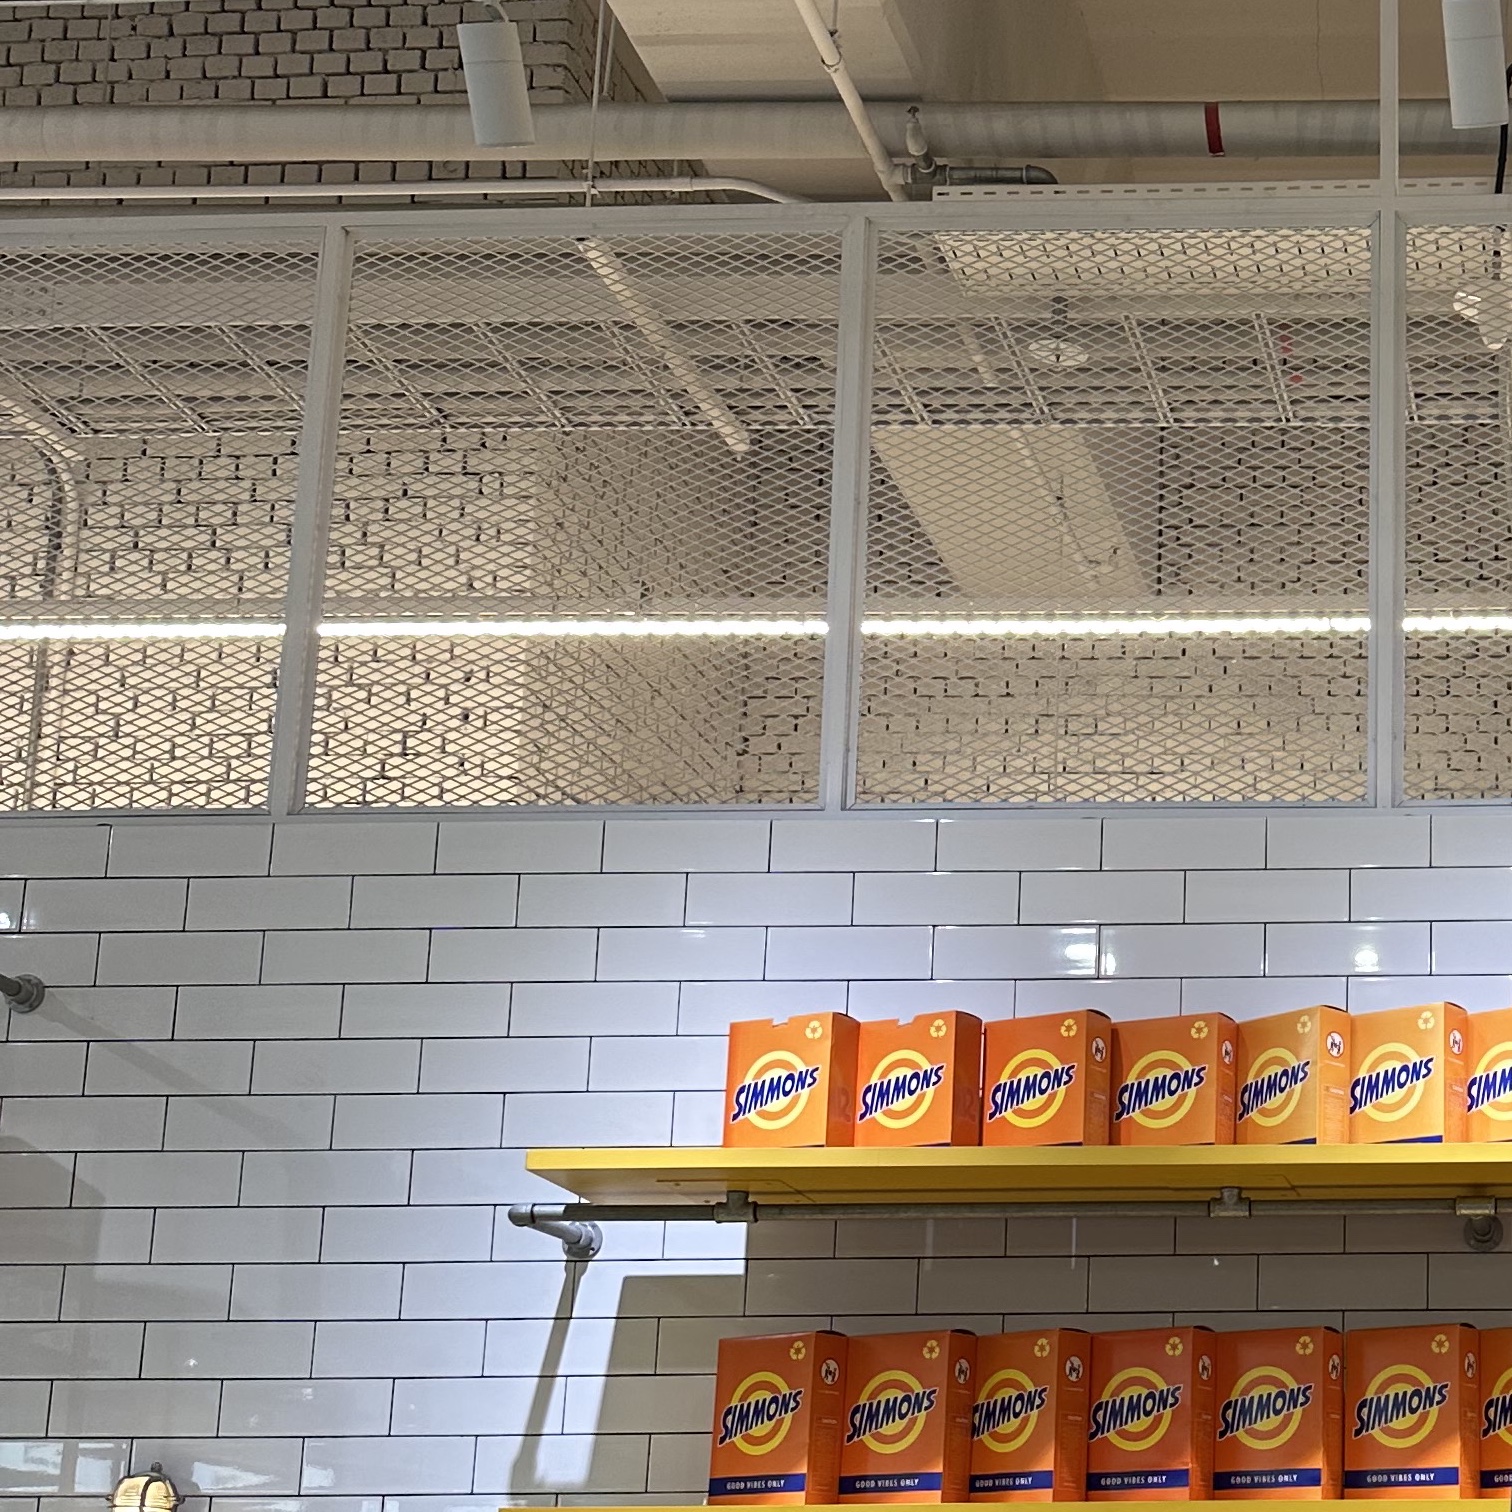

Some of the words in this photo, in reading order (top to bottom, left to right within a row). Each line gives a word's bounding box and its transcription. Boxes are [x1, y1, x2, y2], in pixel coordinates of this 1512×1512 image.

[732, 1066, 819, 1122] SIMMONS
[859, 1065, 944, 1121] SIMMONS
[988, 1064, 1076, 1121] SIMMONS
[1115, 1065, 1206, 1121] SIMMONS
[1238, 1061, 1310, 1122] SIMMONS
[1350, 1057, 1434, 1114] SIMMONS
[719, 1389, 803, 1446] SIMMONS
[846, 1388, 937, 1443] SIMMONS
[1089, 1384, 1182, 1441] SIMMONS
[1218, 1384, 1314, 1440] SIMMONS
[1354, 1383, 1450, 1439] SIMMONS
[726, 1481, 745, 1490] GOOD
[746, 1480, 766, 1489] VIBES
[767, 1479, 785, 1488] ONLY
[855, 1480, 875, 1489] GOOD
[877, 1479, 898, 1488] VIBES
[900, 1478, 919, 1487] ONLY
[975, 1479, 993, 1488] GOOD
[995, 1478, 1014, 1487] VIBES
[1015, 1476, 1033, 1485] ONLY
[1100, 1477, 1122, 1486] GOOD
[1123, 1476, 1145, 1485] VIBES
[1147, 1475, 1167, 1484] ONLY
[1230, 1475, 1252, 1485] GOOD
[1253, 1475, 1276, 1484] VIBES
[1278, 1474, 1298, 1483] ONLY
[1366, 1474, 1388, 1483] GOOD
[1390, 1473, 1412, 1482] VIBES
[1414, 1472, 1435, 1481] ONLY
